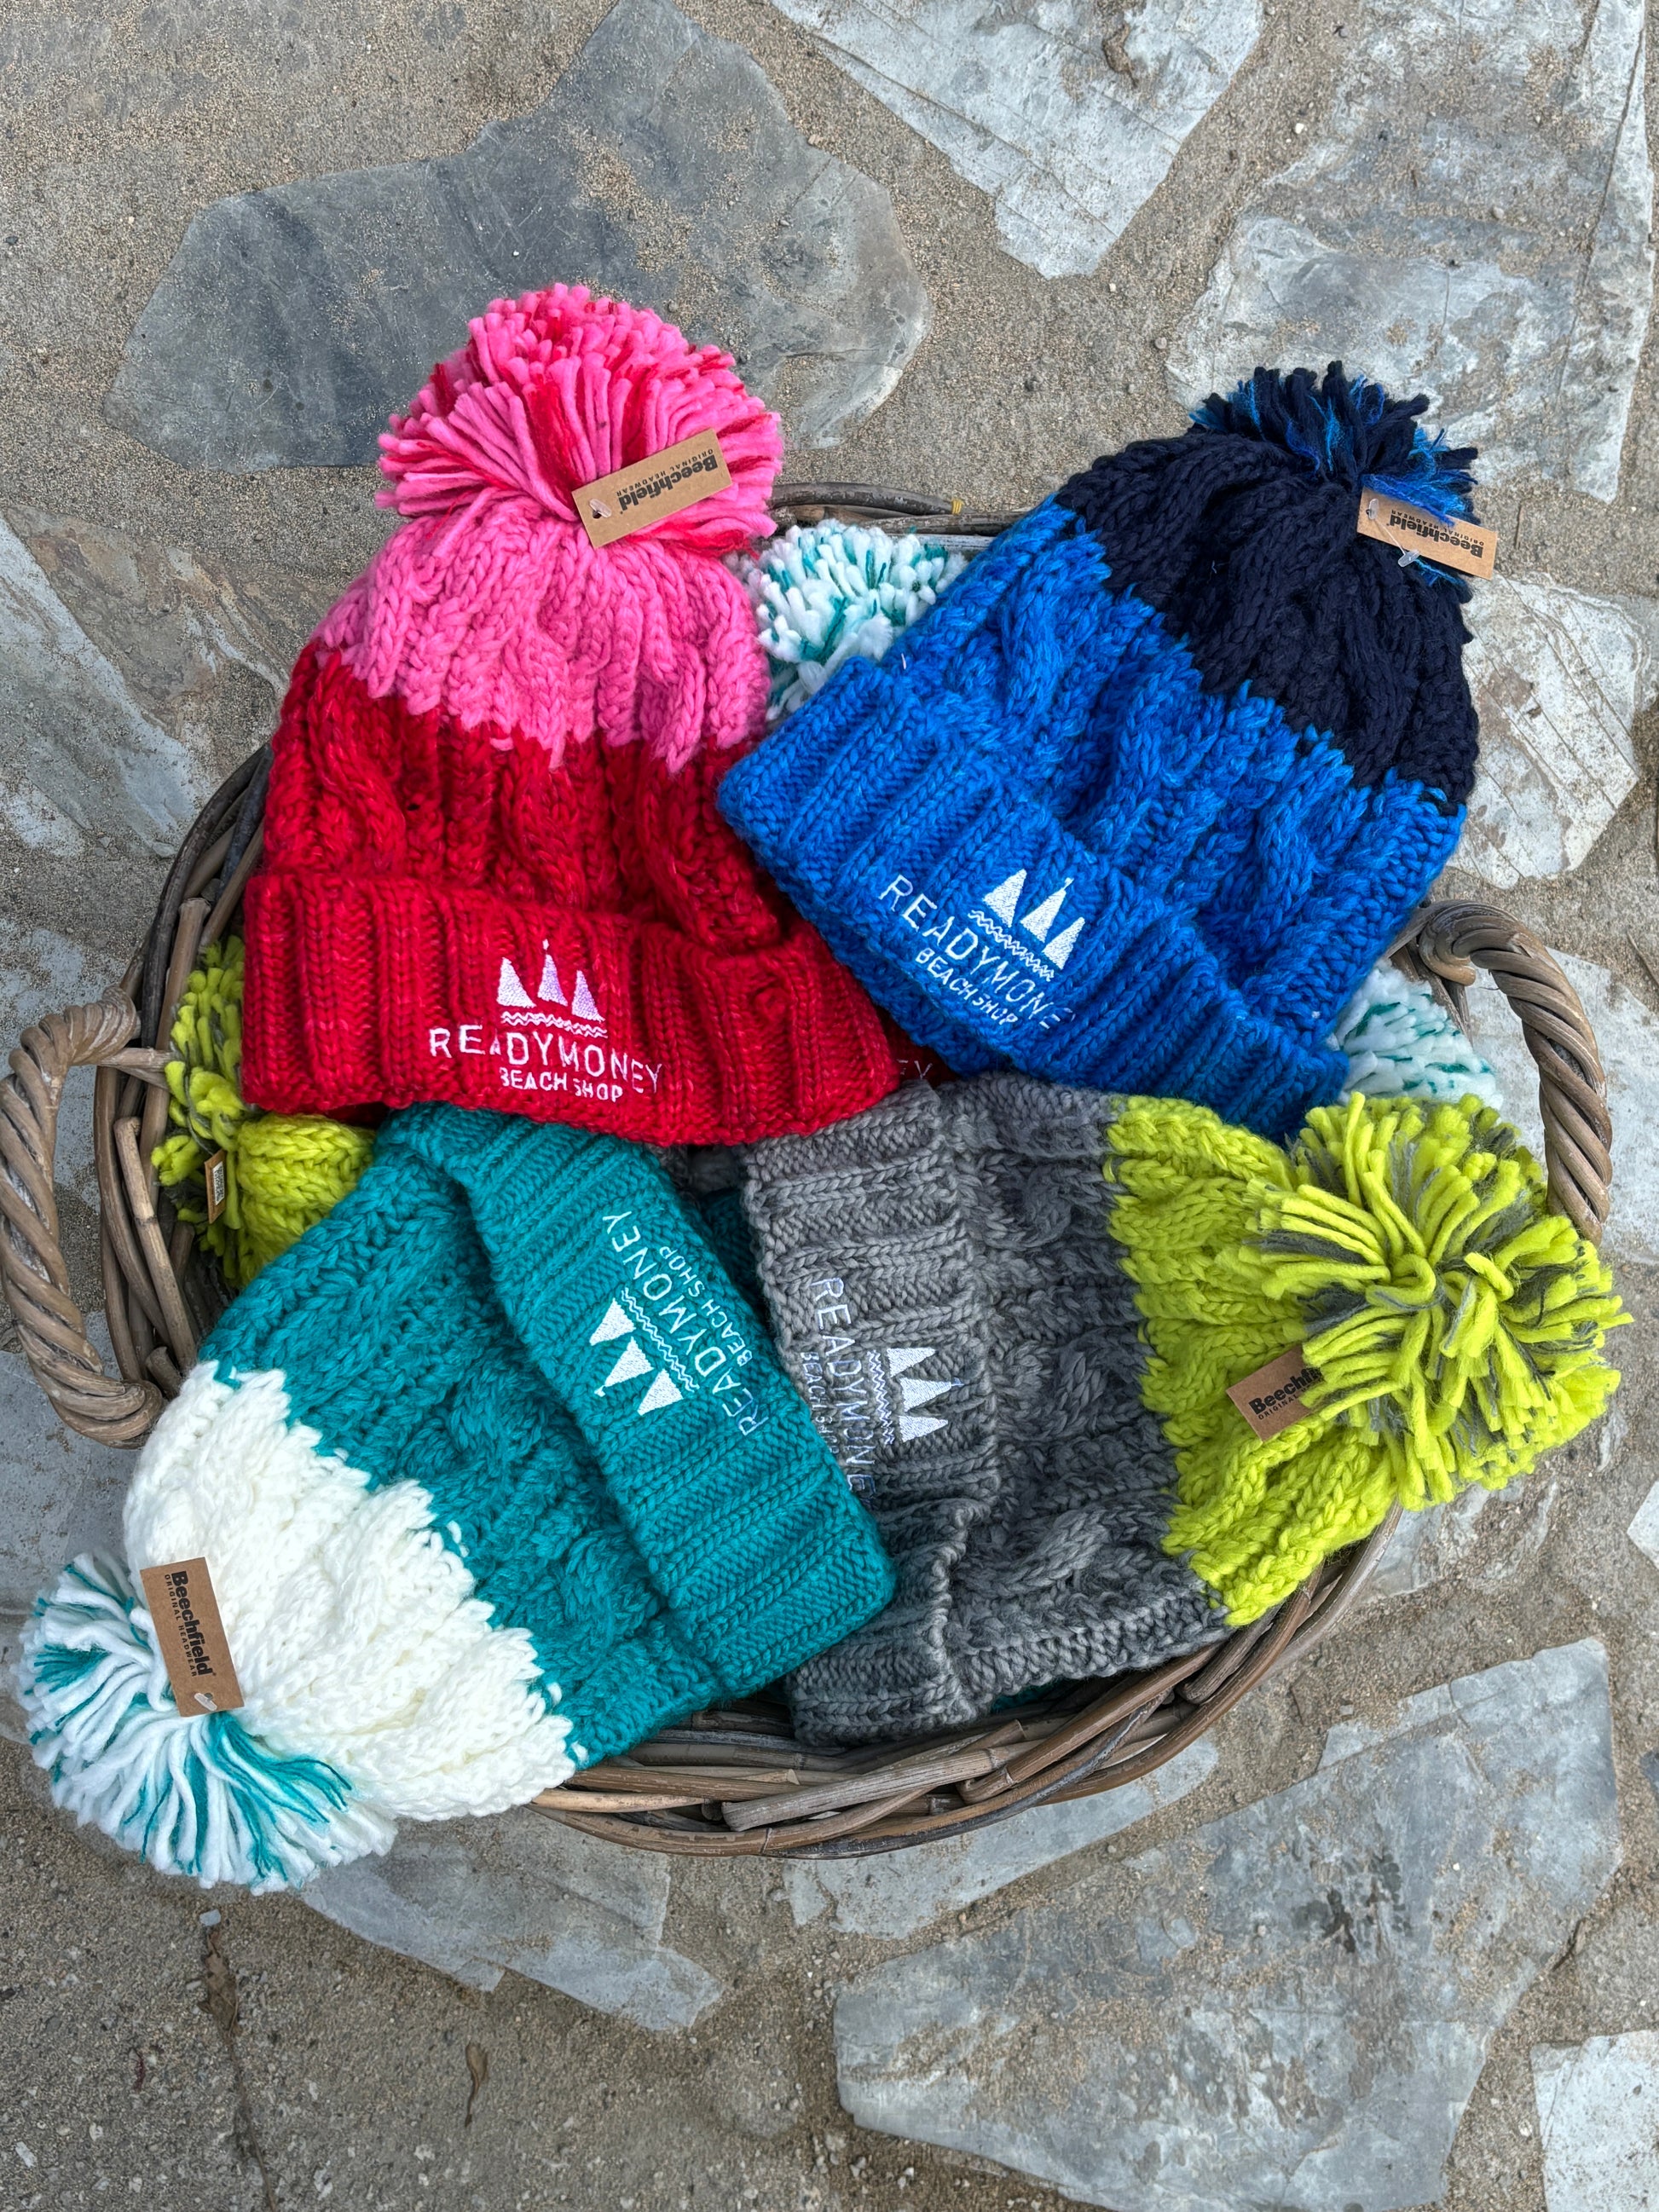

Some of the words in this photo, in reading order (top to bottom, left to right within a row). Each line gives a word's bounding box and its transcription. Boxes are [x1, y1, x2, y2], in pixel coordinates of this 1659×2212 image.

[616, 471, 667, 497] HEADWEAR
[618, 454, 719, 512] Beechfield
[670, 448, 714, 471] ORIGINAL
[1390, 514, 1483, 558] Beechfield
[1391, 509, 1439, 529] HEADWEAR
[1444, 526, 1484, 546] ORIGINAL
[878, 874, 1076, 1030] READYMONE
[916, 947, 979, 1001] BEACH
[972, 993, 1019, 1025] SHOP
[429, 1024, 662, 1094] READYMONEY
[499, 1066, 568, 1091] BEACH
[573, 1077, 623, 1102] SHOP
[659, 1245, 706, 1297] SHOP
[602, 1210, 770, 1436] READYMONEY
[701, 1298, 753, 1367] BEACH
[801, 1351, 827, 1408] BEACH
[811, 1277, 878, 1502] READYMONE
[1257, 1394, 1298, 1420] ORIGINAL
[165, 1574, 181, 1621] ORIGINAL
[177, 1625, 197, 1678] HEADWEAR
[171, 1570, 213, 1677] Beechfield
